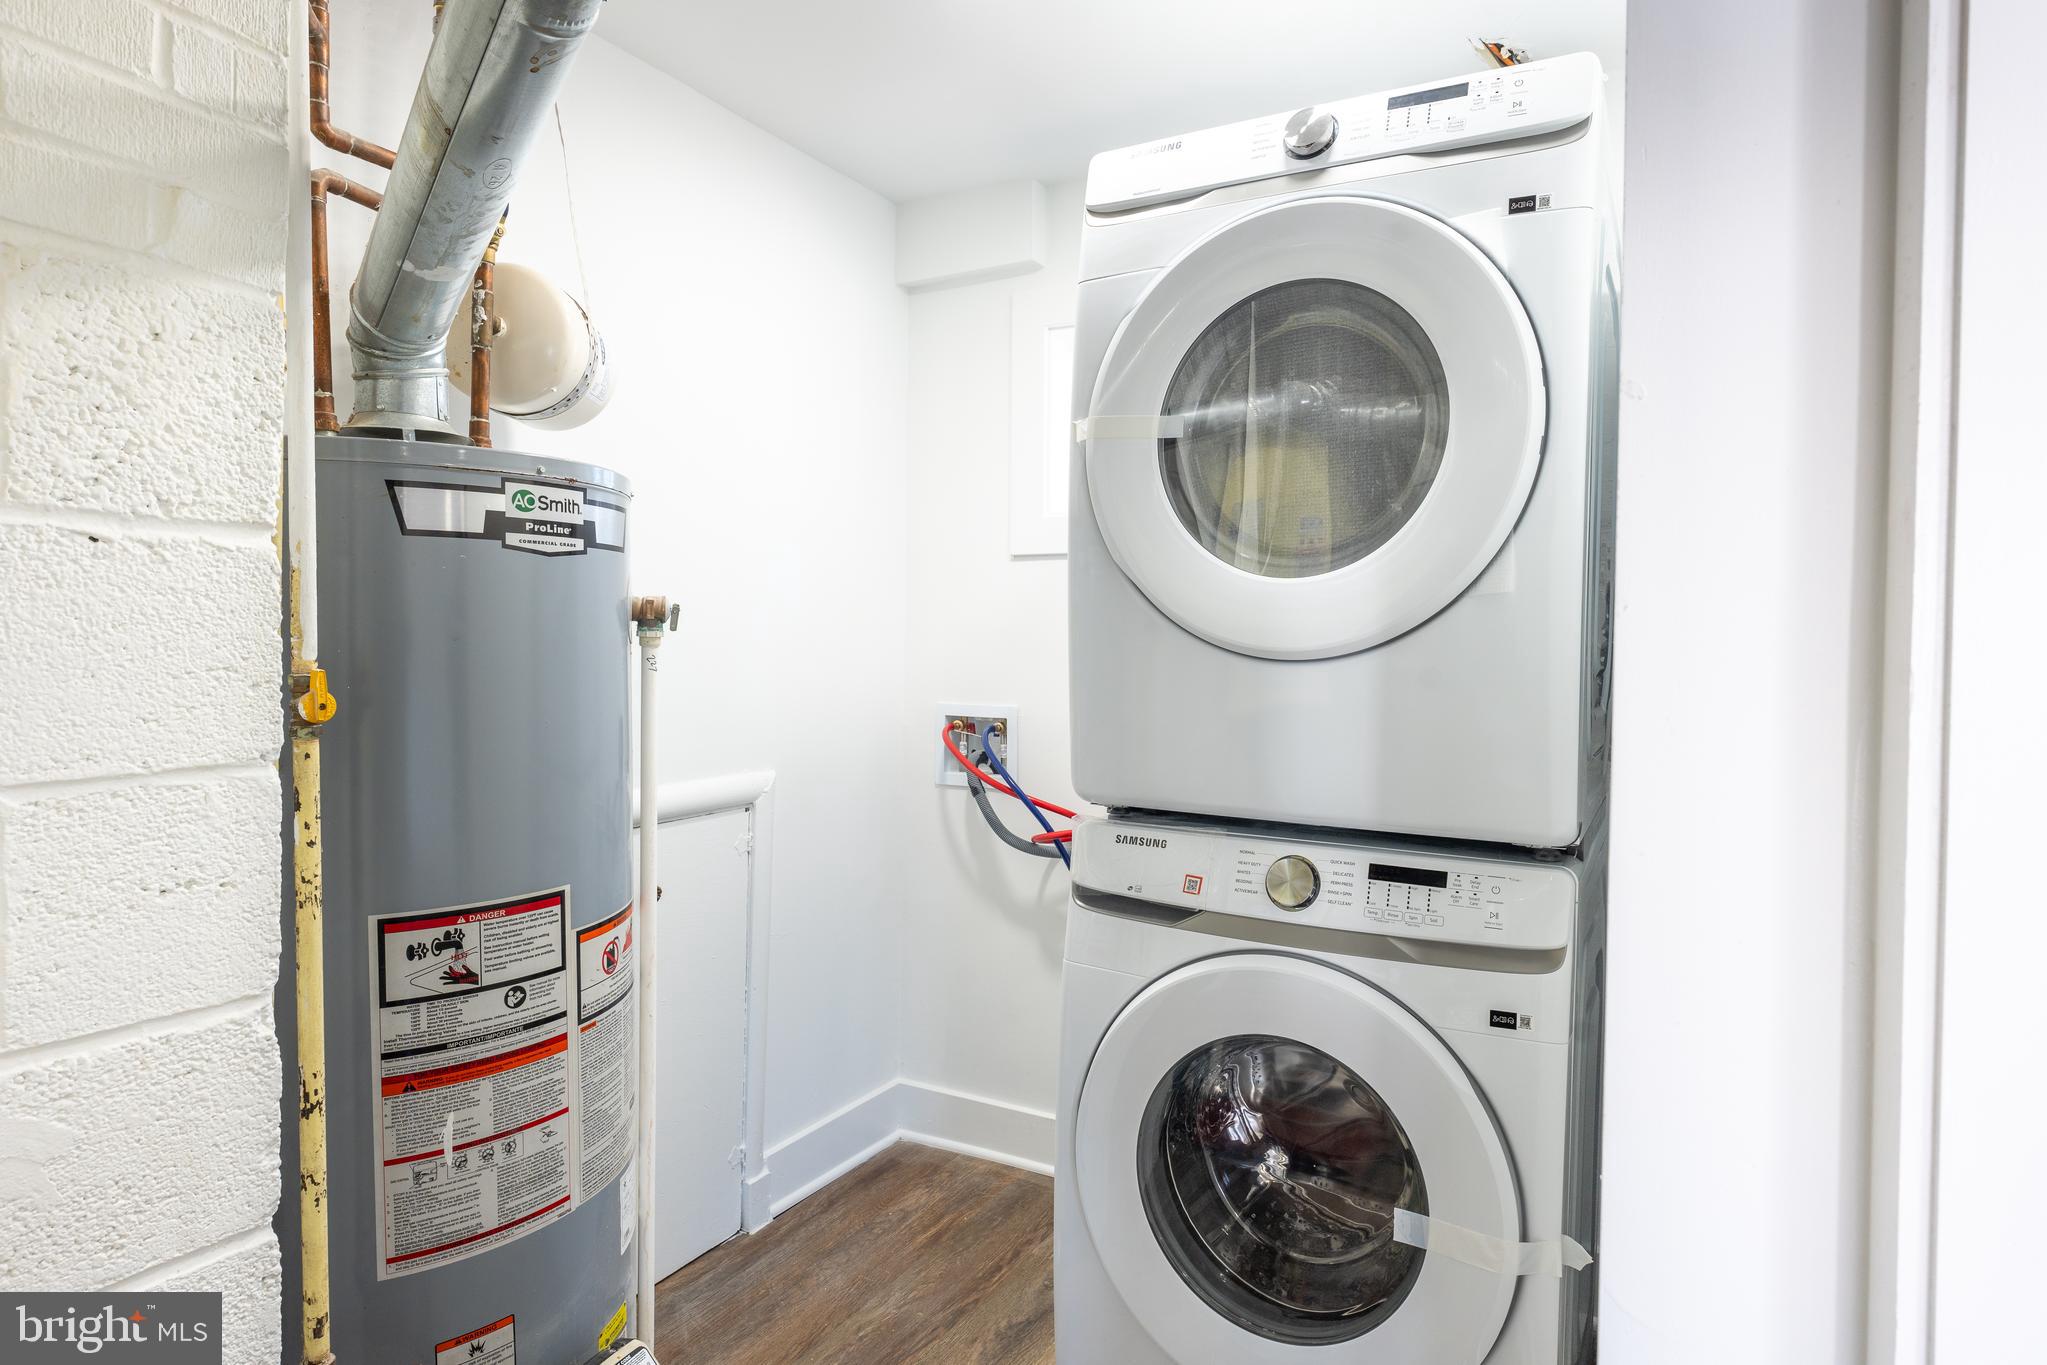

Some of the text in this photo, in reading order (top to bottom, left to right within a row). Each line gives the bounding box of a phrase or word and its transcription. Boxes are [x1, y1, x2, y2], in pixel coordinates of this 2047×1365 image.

[537, 495, 580, 514] Smith
[526, 522, 570, 534] ProLine
[1116, 835, 1167, 848] SAMSUNG
[469, 910, 506, 921] DANGER
[464, 1324, 497, 1340] WARNING
